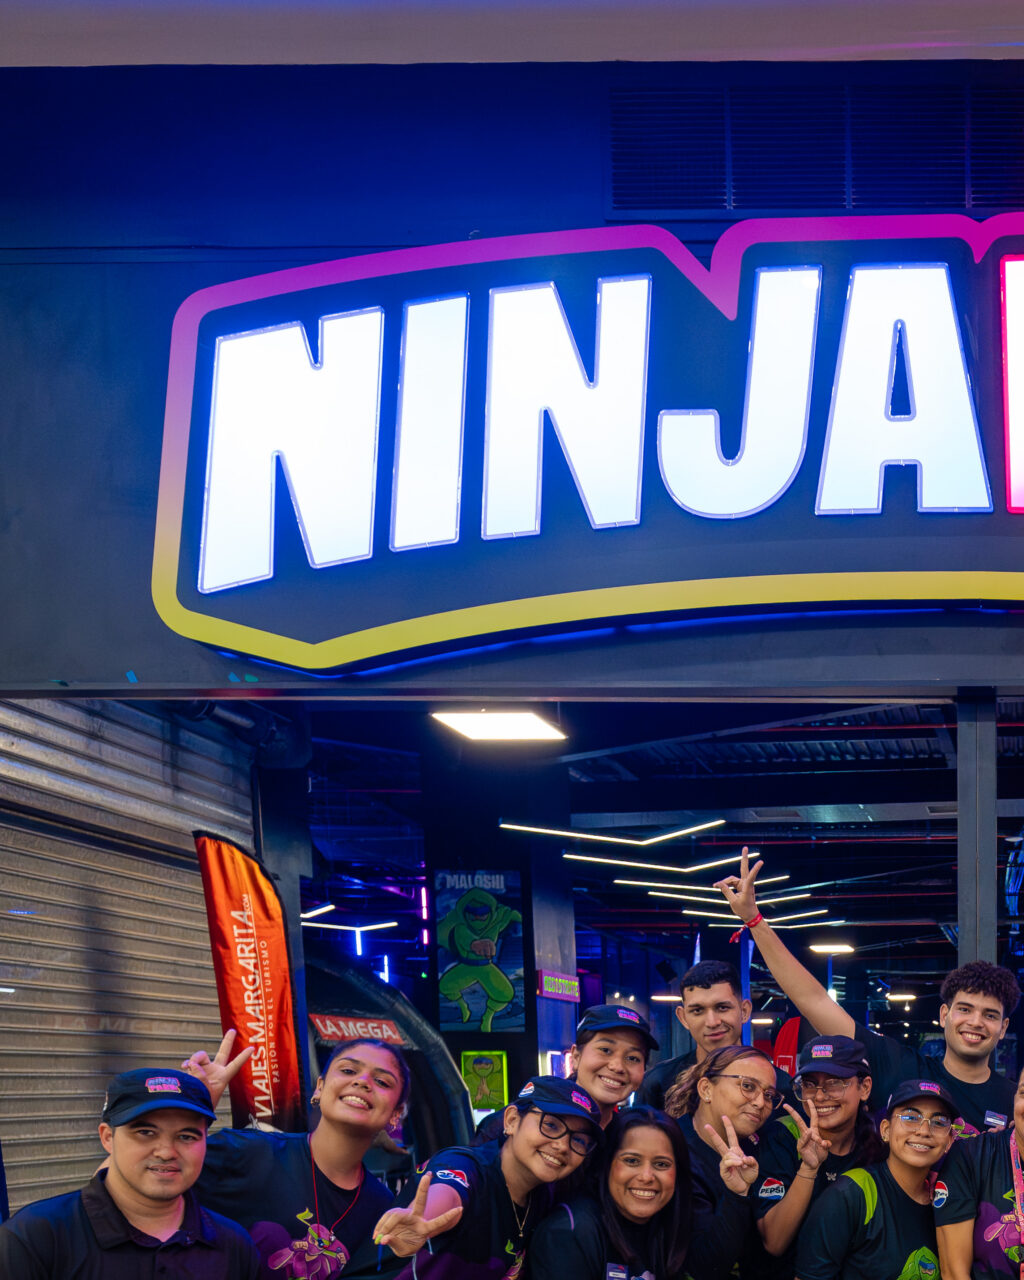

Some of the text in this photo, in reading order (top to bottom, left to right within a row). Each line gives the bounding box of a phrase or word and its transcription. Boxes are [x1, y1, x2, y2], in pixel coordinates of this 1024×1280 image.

[259, 940, 273, 992] TURISMO
[266, 997, 274, 1010] EL
[315, 1018, 341, 1037] LA
[760, 1186, 784, 1195] PEPSI
